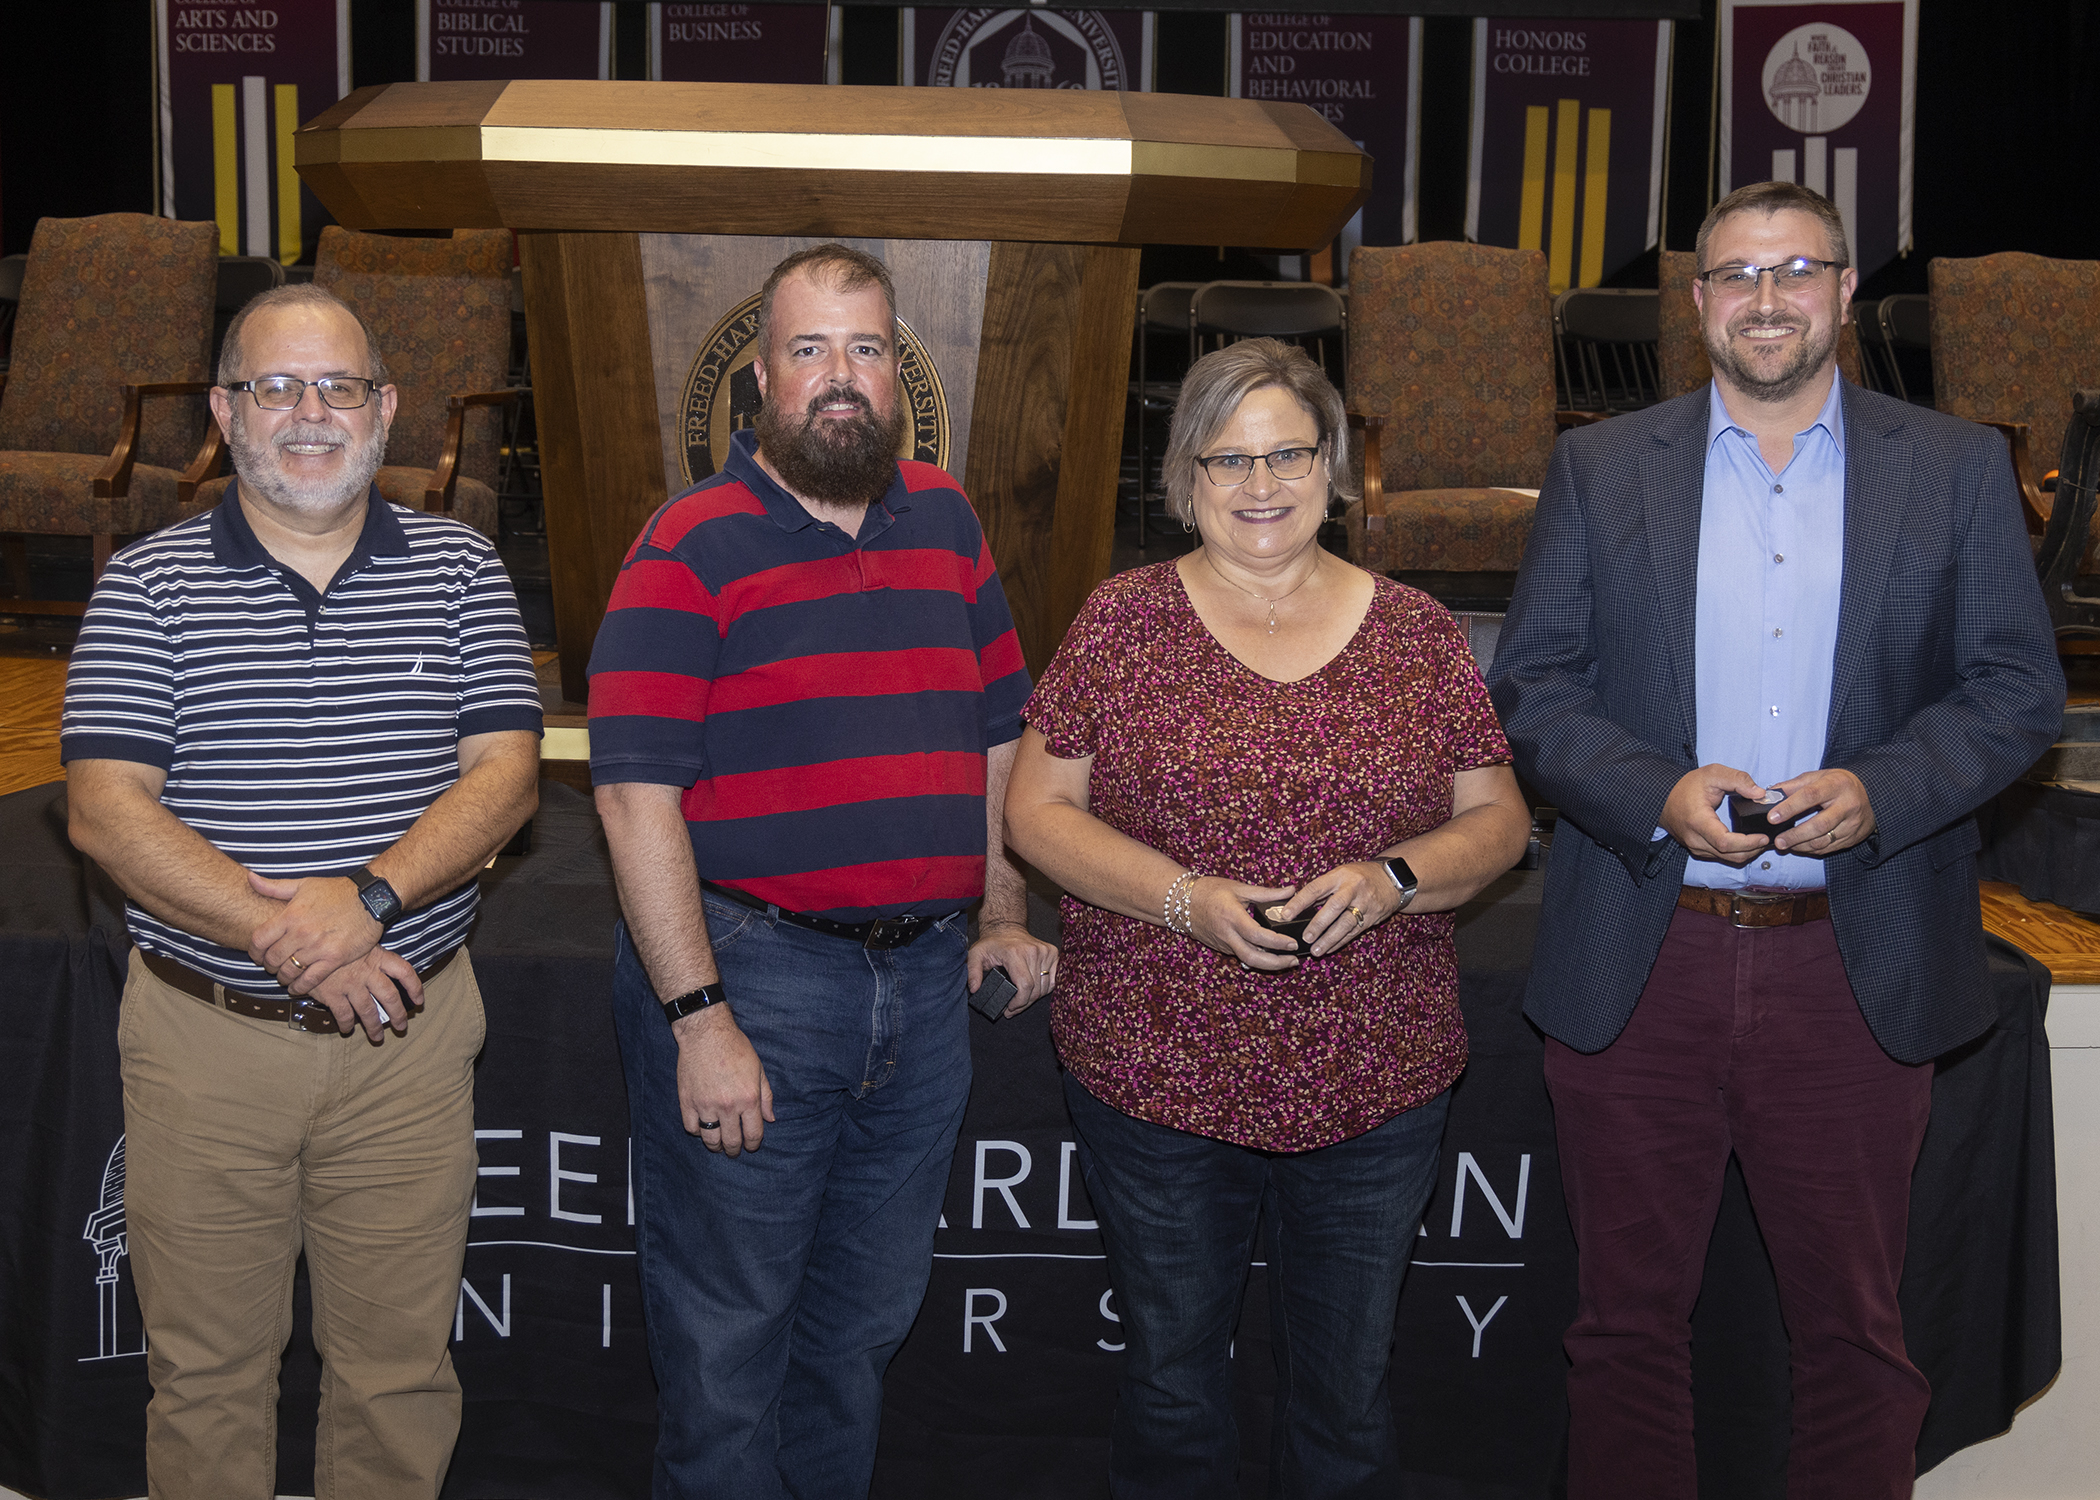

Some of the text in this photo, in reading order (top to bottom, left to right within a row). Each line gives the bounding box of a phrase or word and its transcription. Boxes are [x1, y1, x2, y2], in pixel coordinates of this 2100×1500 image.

[175, 9, 279, 29] ARTS AND
[667, 4, 729, 17] COLLEGE
[1248, 13, 1310, 26] COLLEGE
[437, 12, 530, 33] BIBLICAL
[668, 21, 763, 42] BUSINESS
[175, 33, 276, 52] SCIENCES
[436, 36, 525, 57] STUDIES
[1249, 31, 1373, 51] EDUCATION
[1495, 29, 1587, 52] HONORS
[1249, 55, 1296, 75] AND
[1493, 53, 1591, 76] COLLEGE
[1821, 71, 1867, 83] CHRISTIAN
[1248, 78, 1377, 99] BEHAVIORAL
[899, 340, 938, 455] VERSITY
